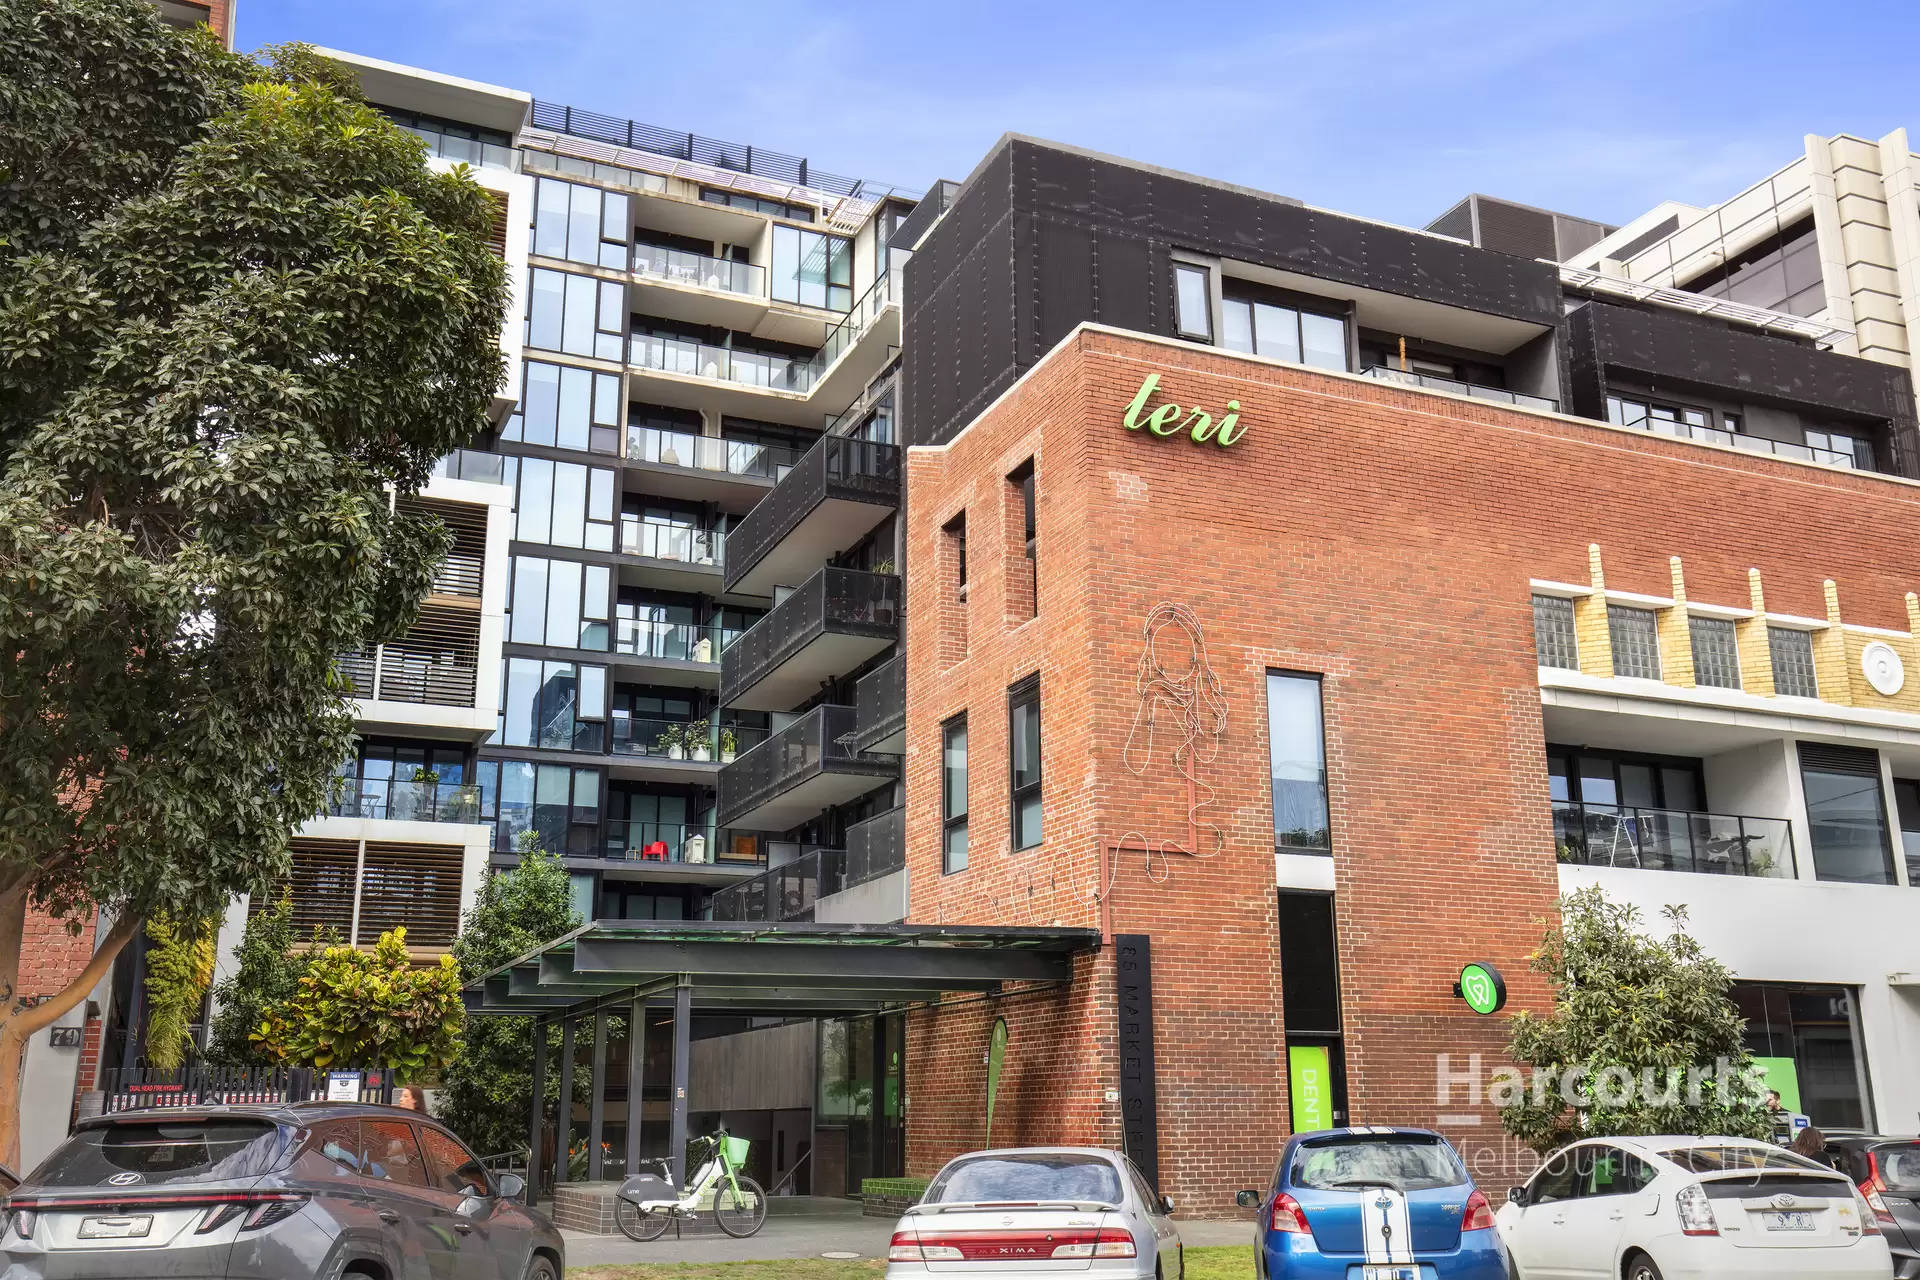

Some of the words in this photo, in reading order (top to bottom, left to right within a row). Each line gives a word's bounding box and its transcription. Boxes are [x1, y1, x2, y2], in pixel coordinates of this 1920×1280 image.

[1122, 946, 1138, 972] 85
[52, 1028, 80, 1046] 79
[1123, 985, 1142, 1084] MARKET
[1301, 1069, 1321, 1133] DENT
[1127, 1097, 1145, 1173] STRE
